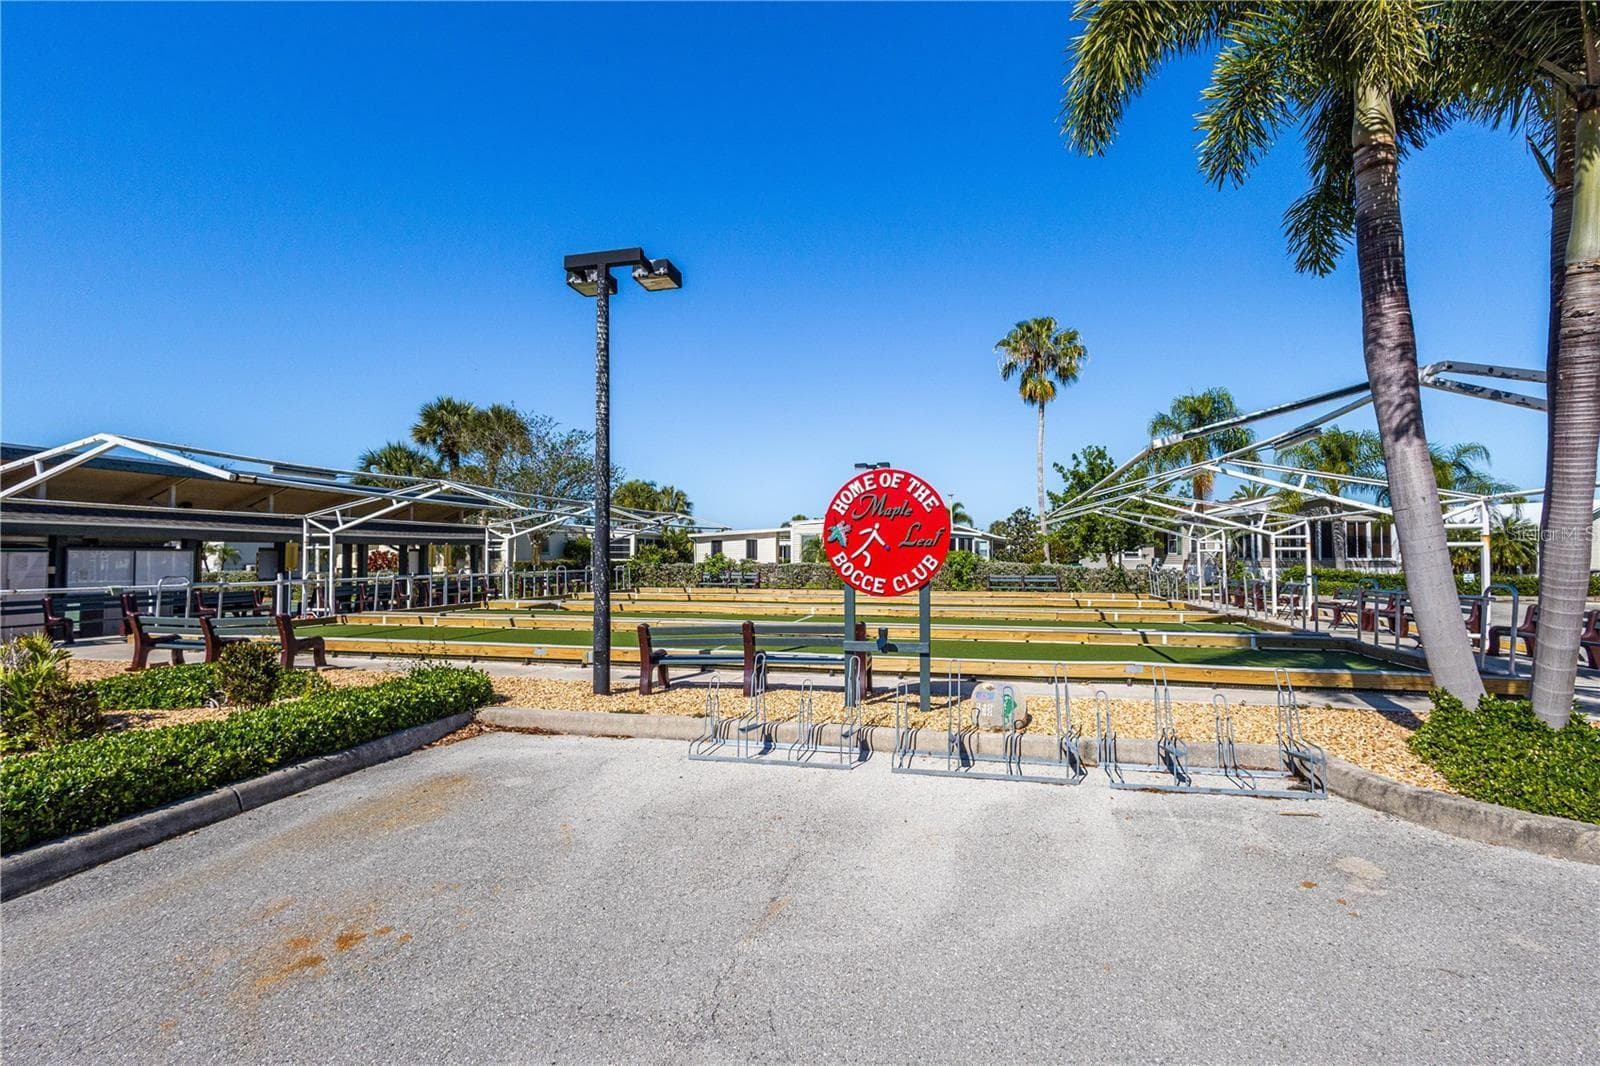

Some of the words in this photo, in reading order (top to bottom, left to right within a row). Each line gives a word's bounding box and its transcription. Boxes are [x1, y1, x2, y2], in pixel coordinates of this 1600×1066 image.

[832, 474, 877, 516] HOME
[879, 472, 905, 489] OF
[906, 477, 940, 513] THE
[851, 493, 913, 520] Maple
[898, 521, 946, 548] Leaf
[832, 551, 886, 594] BOCCE
[892, 554, 939, 592] CLUB
